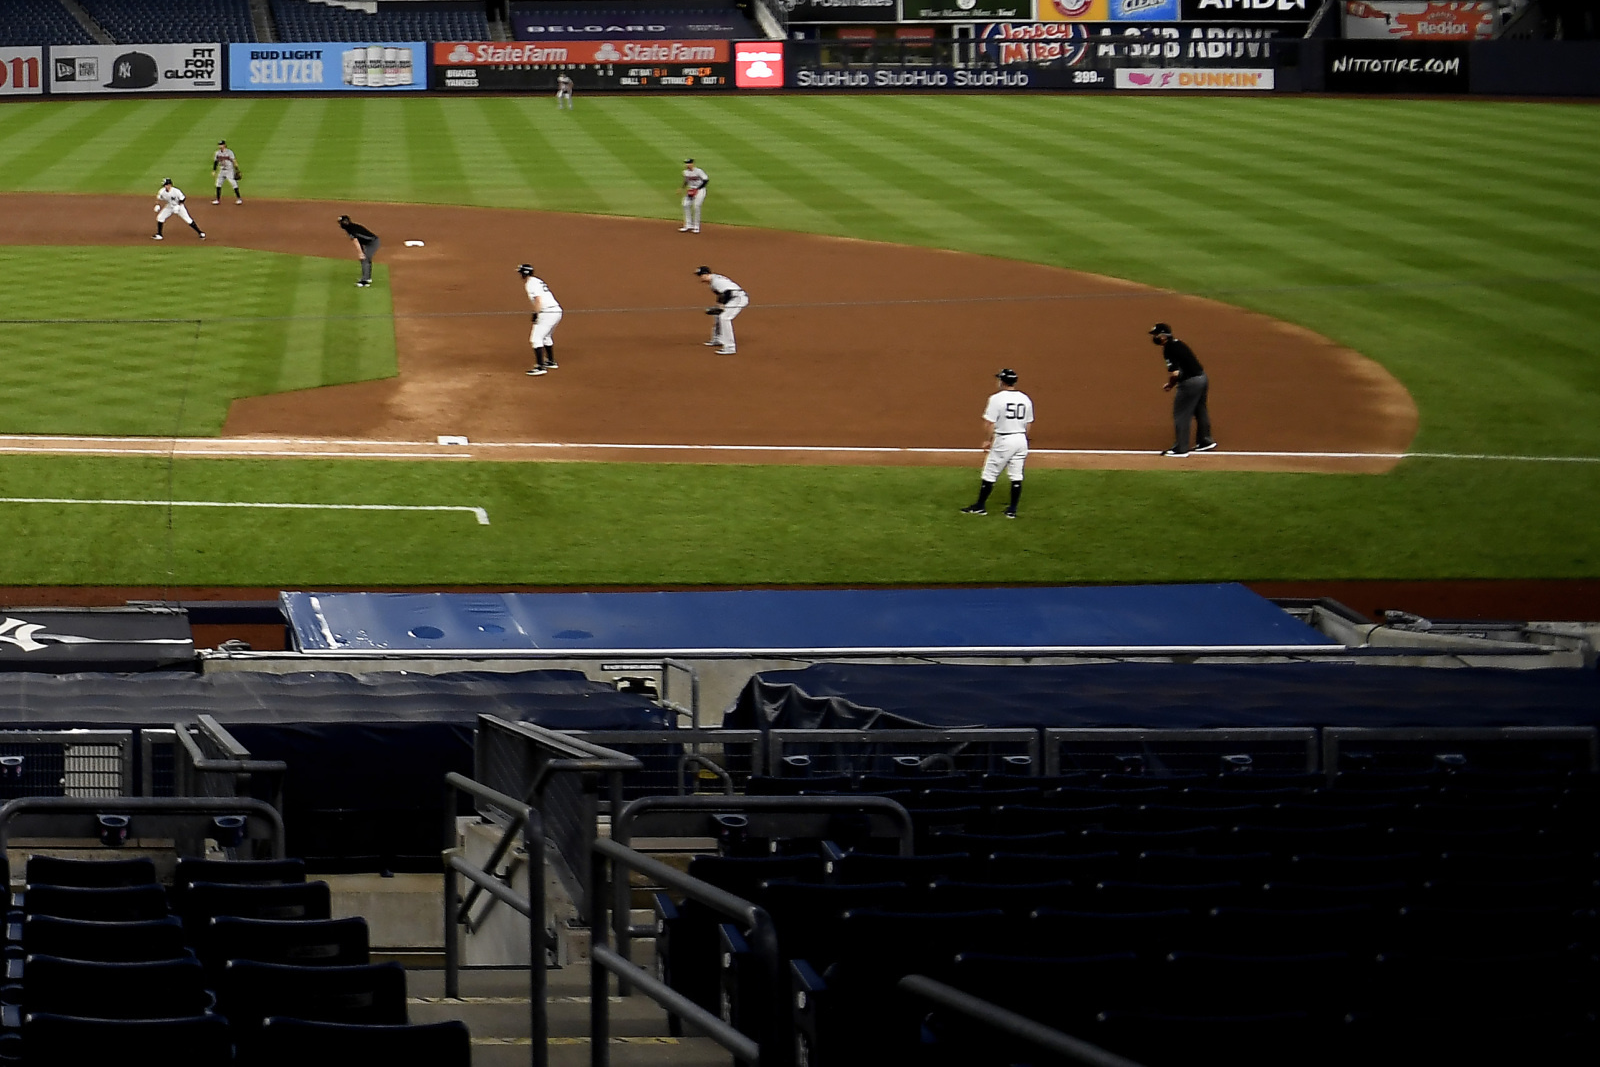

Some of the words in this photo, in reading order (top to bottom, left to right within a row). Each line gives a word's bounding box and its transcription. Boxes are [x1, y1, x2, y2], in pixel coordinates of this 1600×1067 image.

[527, 25, 666, 33] BELGARD
[1418, 21, 1468, 34] RedHot
[193, 48, 214, 58] FIT
[251, 51, 279, 60] BUD
[282, 50, 323, 60] LIGHT
[185, 59, 214, 68] FOR
[1333, 56, 1459, 74] NITTOTIRE.COM
[164, 69, 214, 79] GLORY
[250, 60, 324, 83] SELTZER
[797, 71, 869, 86] StubHub
[875, 71, 948, 86] StubHub
[954, 71, 1028, 86] StubHub
[1178, 72, 1263, 86] DUNKIN'
[1006, 403, 1026, 420] 50
